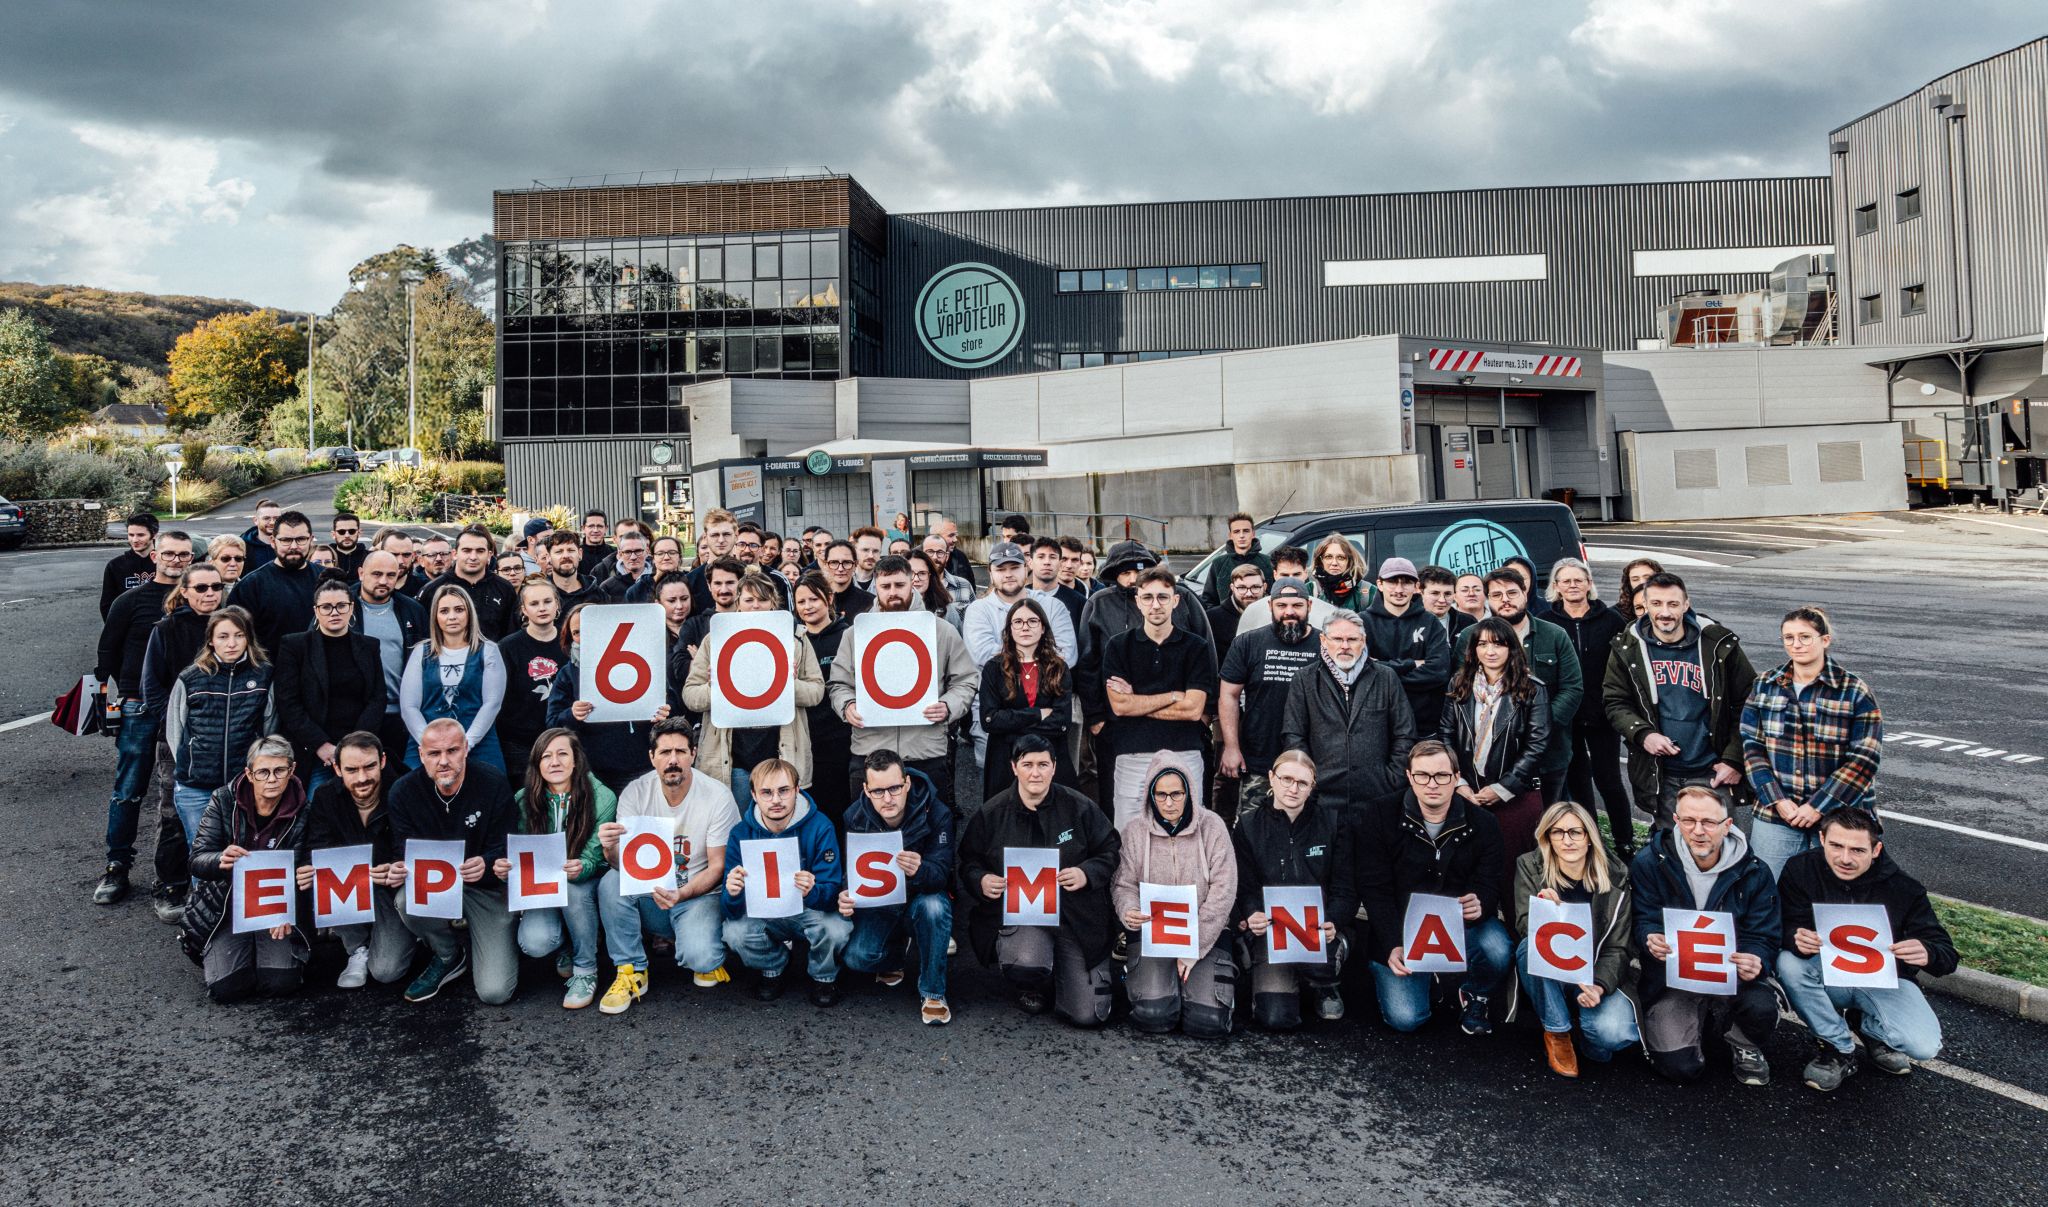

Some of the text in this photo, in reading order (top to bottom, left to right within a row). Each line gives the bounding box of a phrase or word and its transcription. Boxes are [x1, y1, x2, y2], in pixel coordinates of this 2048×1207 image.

[936, 283, 990, 314] LE PETIT
[937, 303, 1006, 338] VAPOTEUR
[961, 339, 983, 353] store
[1483, 357, 1504, 368] Hauteur
[1517, 360, 1528, 370] 3,50
[765, 461, 801, 470] E-CIGARETTES
[837, 459, 864, 467] E-LIQUIDES
[1448, 551, 1461, 569] LE
[1464, 538, 1497, 566] PETIT
[1412, 626, 1426, 643] K
[1652, 660, 1702, 693] EVI'S
